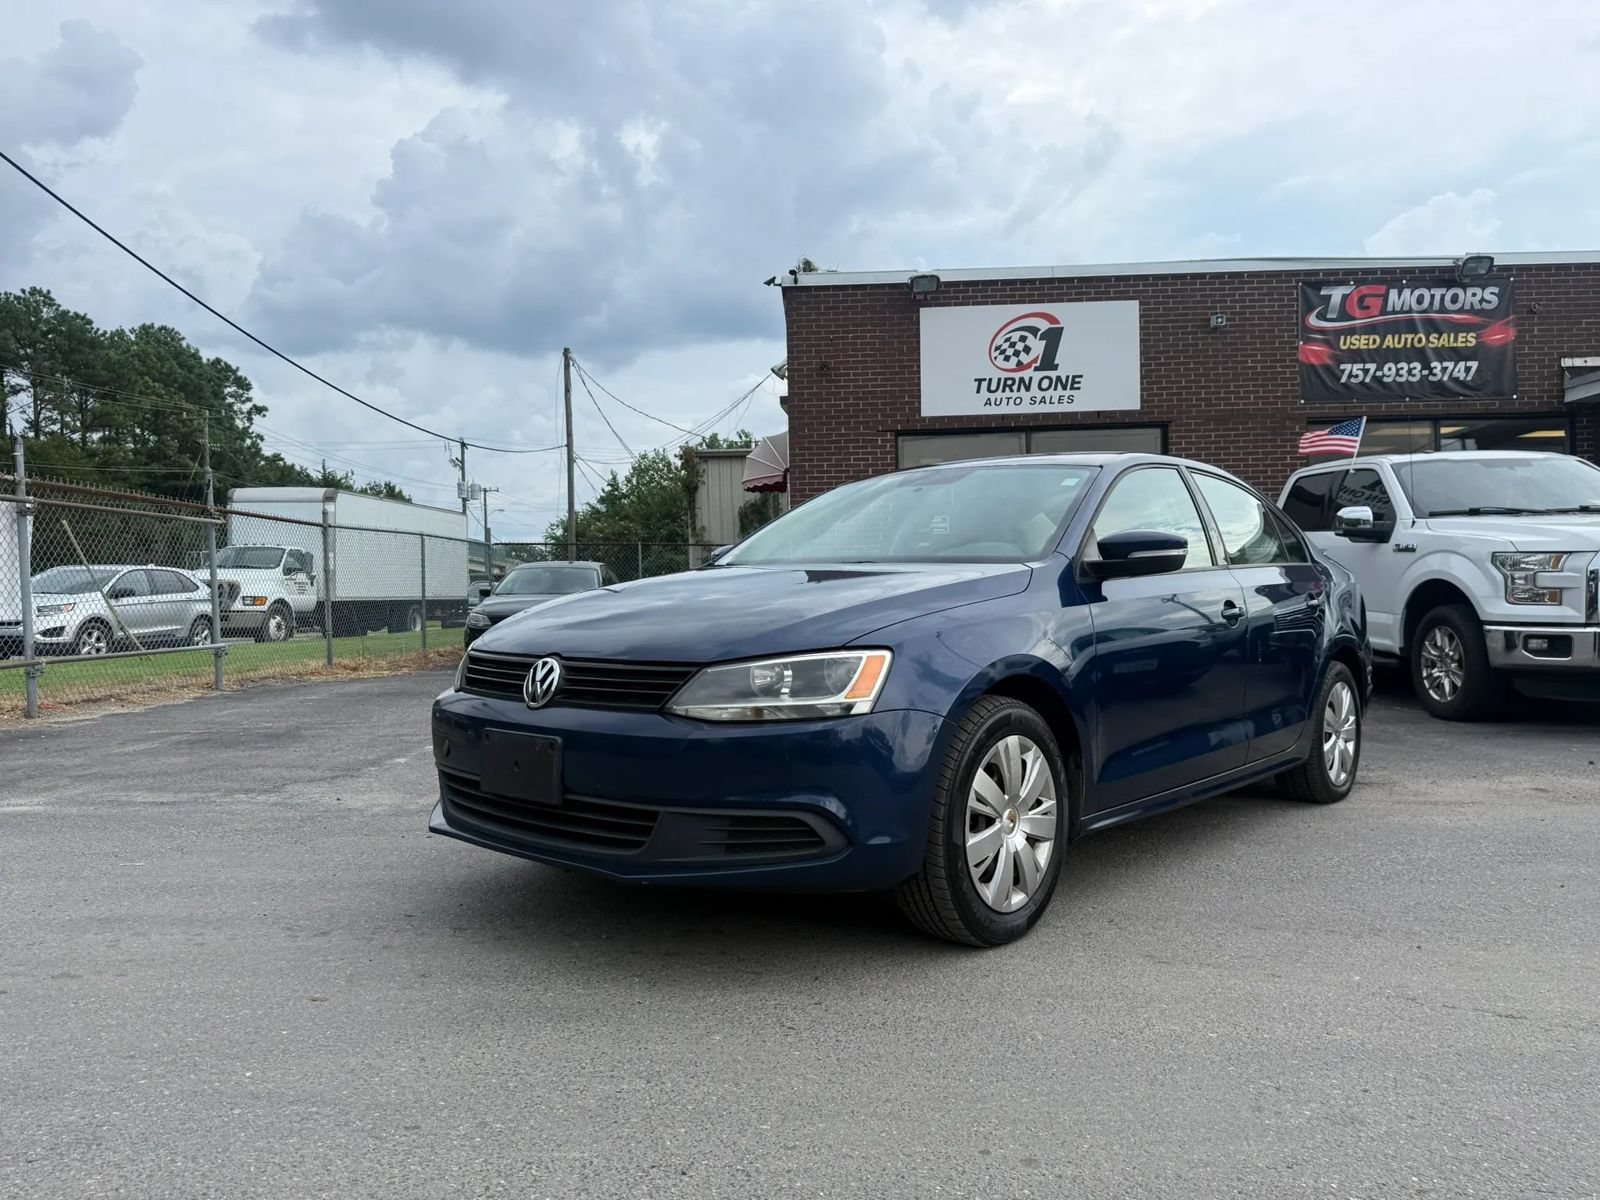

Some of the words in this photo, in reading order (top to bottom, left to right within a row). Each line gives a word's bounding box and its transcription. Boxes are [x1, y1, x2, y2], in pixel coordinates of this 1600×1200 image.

[1320, 284, 1387, 319] TG
[1387, 286, 1499, 312] MOTORS
[1339, 334, 1380, 350] USED
[1382, 333, 1426, 349] AUTO
[1428, 332, 1477, 347] SALES
[1339, 361, 1479, 384] 757-933-3747
[974, 376, 1033, 394] TURN
[1037, 374, 1083, 392] ONE
[984, 396, 1023, 407] AUTO
[1029, 394, 1075, 405] SALES
